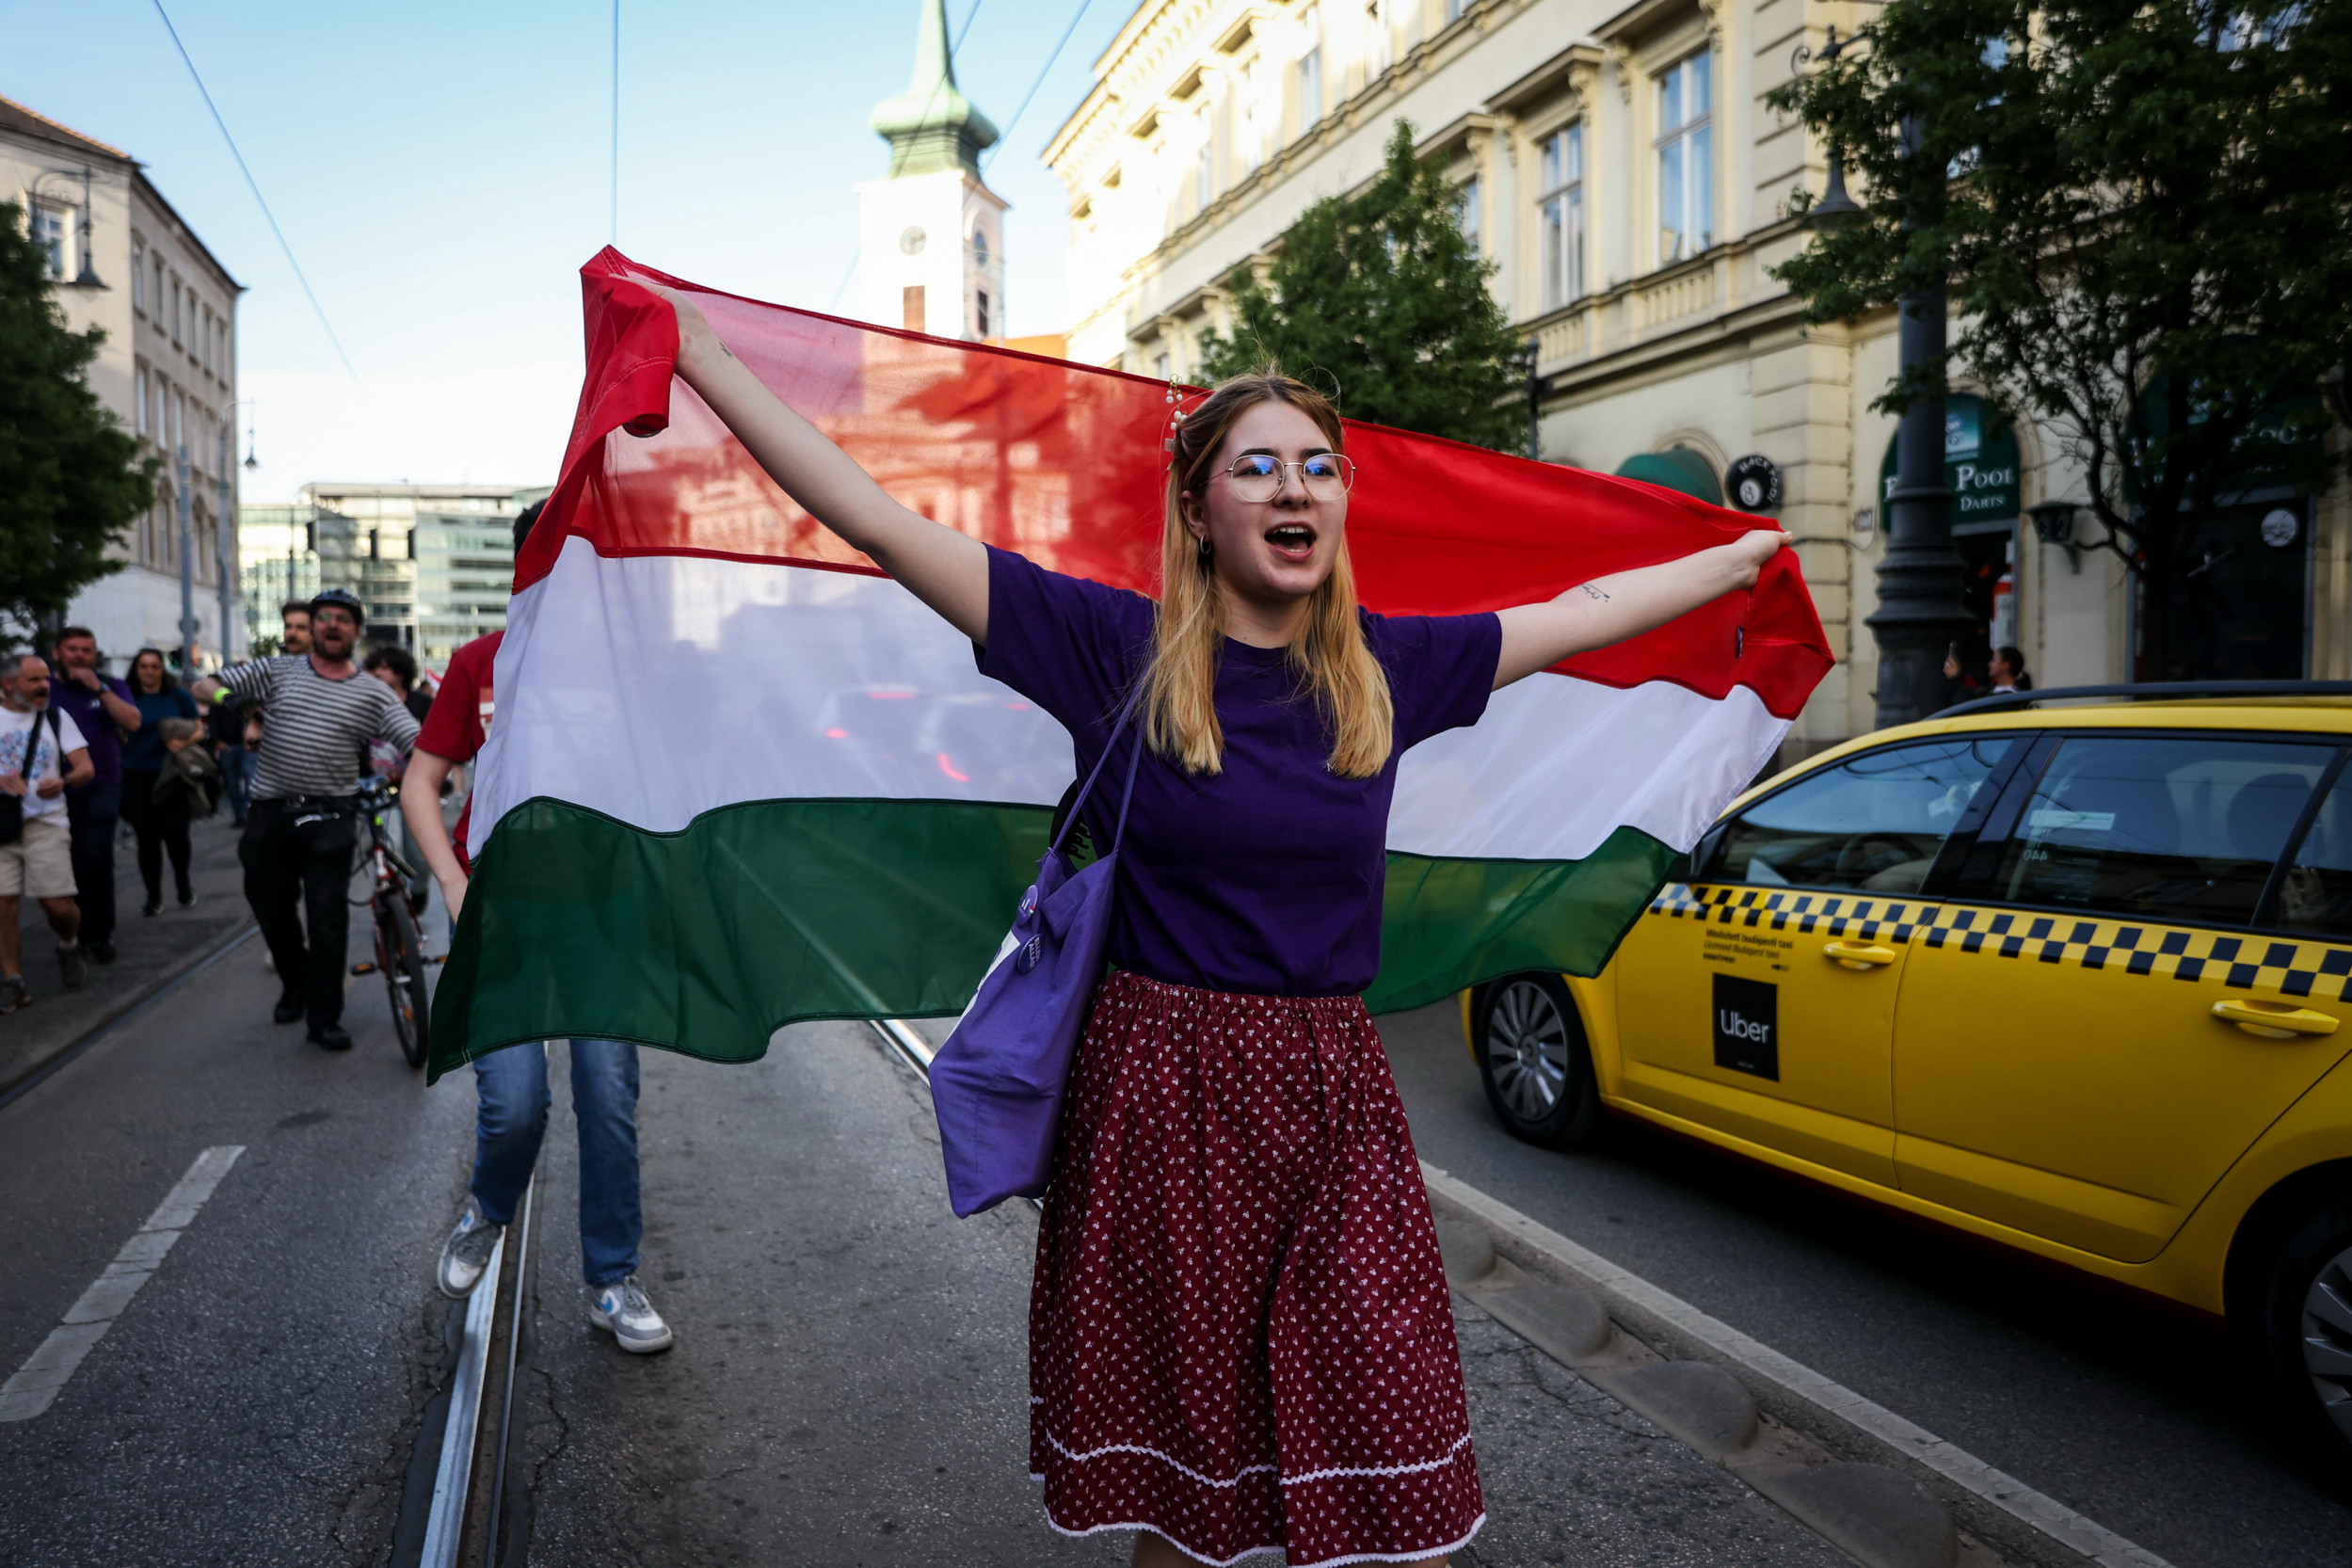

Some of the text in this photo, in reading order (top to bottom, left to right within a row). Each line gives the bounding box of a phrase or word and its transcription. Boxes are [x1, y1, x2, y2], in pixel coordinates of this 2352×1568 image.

[1737, 457, 1778, 503] BLACK POOL
[1744, 485, 1754, 503] 8
[1704, 940, 1780, 959] Licensed Budapest taxi
[1741, 935, 1777, 947] budapesti
[1778, 939, 1793, 949] taxi
[1720, 1008, 1769, 1044] Uber
